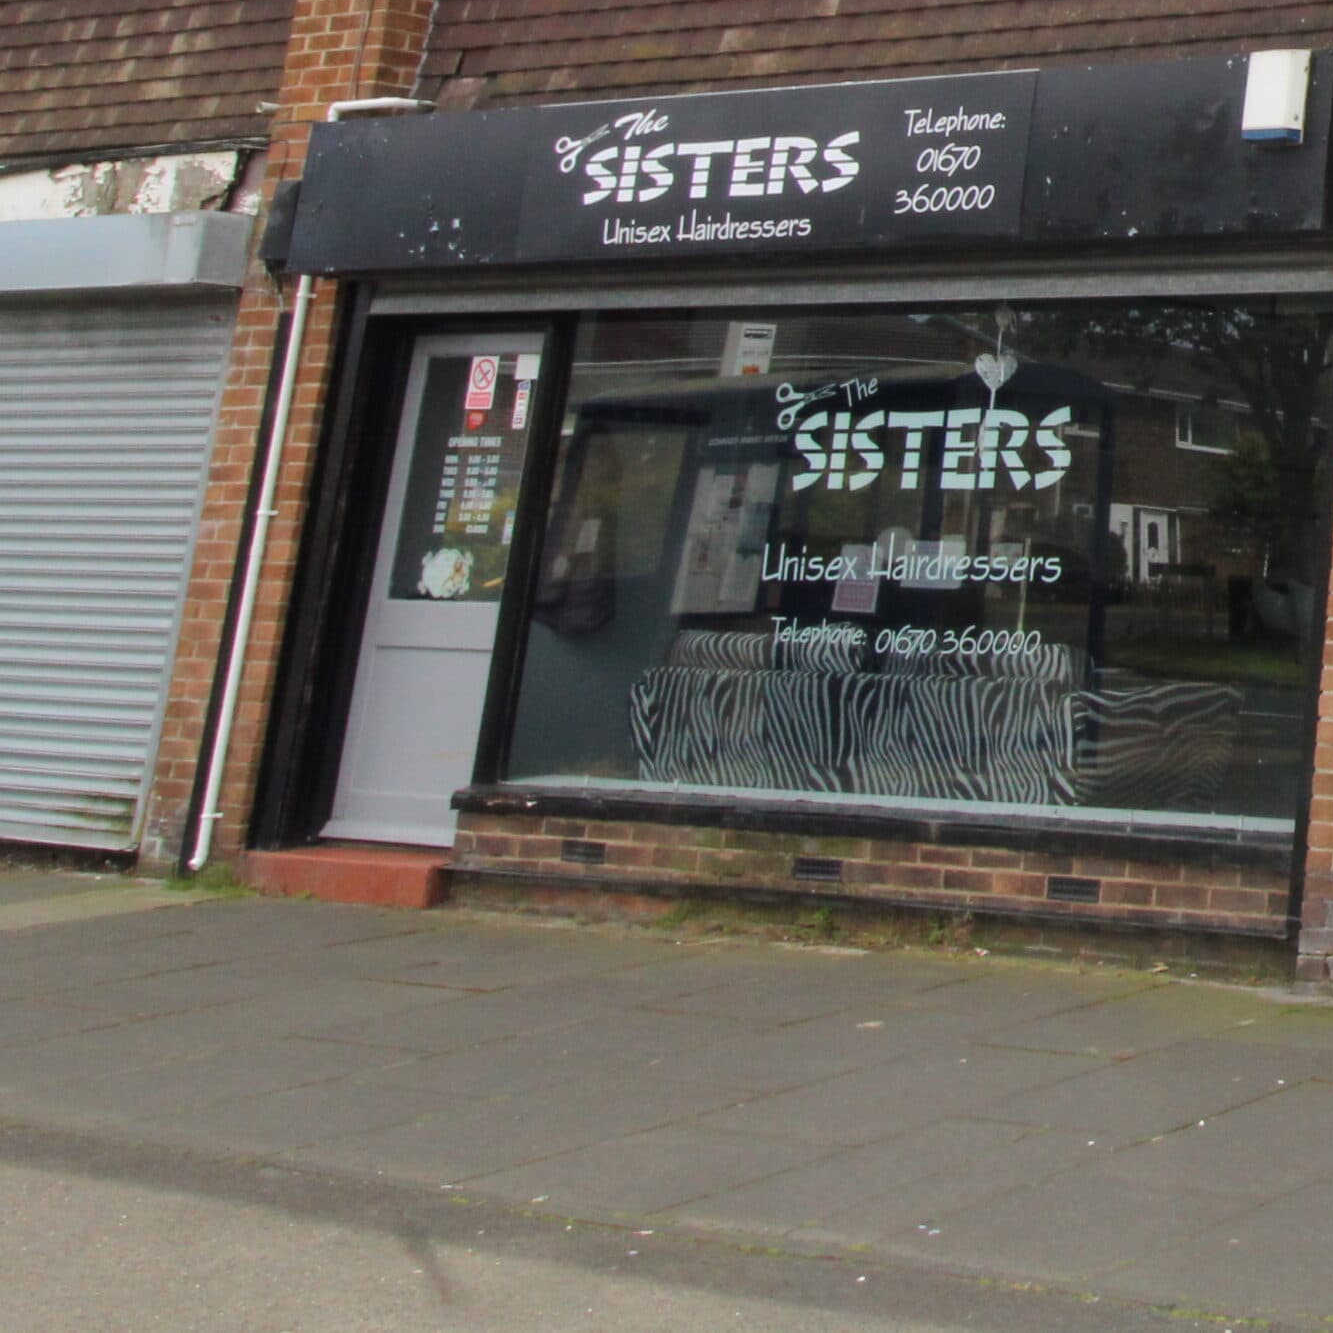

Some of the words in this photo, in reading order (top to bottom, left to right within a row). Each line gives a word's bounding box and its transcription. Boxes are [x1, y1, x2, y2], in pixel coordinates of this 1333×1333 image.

[615, 108, 669, 140] The
[904, 106, 1006, 137] Telephone:
[583, 131, 860, 206] SISTERS
[916, 142, 981, 177] 01670
[894, 183, 995, 214] 360000
[603, 218, 672, 245] Unisex
[676, 208, 812, 242] Hairdressers
[841, 377, 878, 407] The
[792, 406, 1072, 490] SISTERS
[762, 542, 858, 582] Unisex
[867, 531, 1063, 583] Hairdressers
[875, 623, 937, 659] 01670
[942, 624, 1041, 656] 360000
